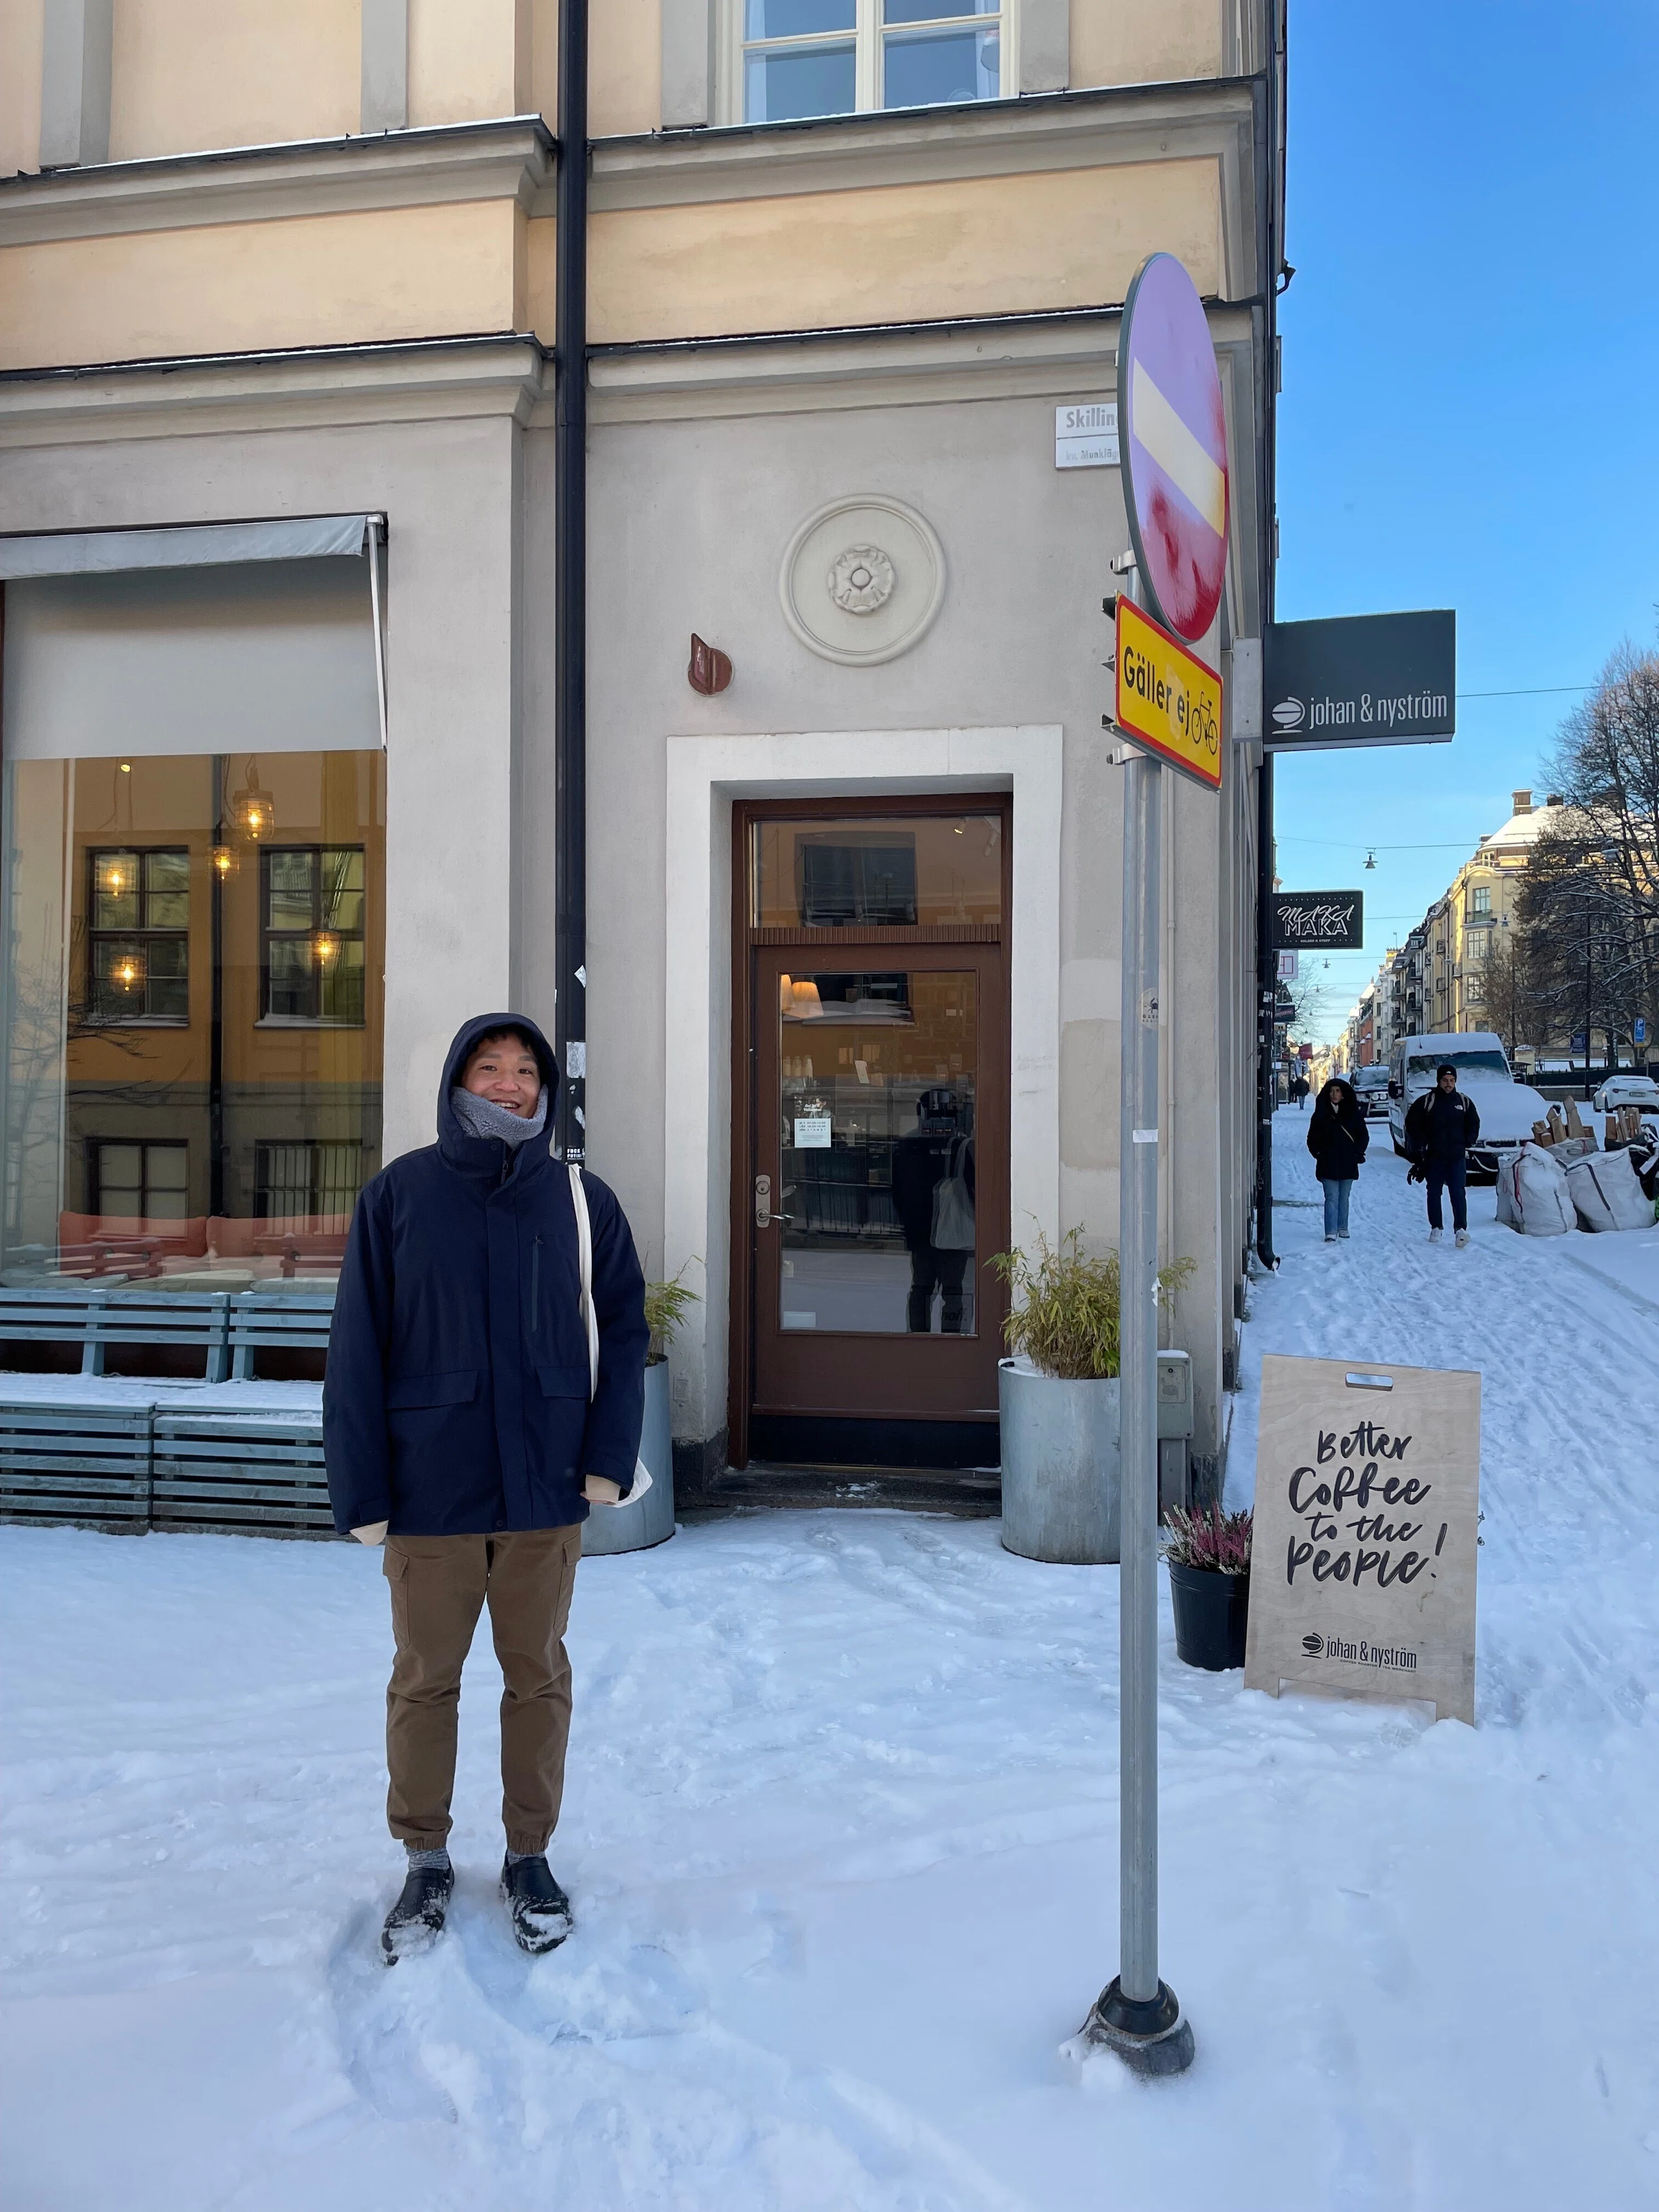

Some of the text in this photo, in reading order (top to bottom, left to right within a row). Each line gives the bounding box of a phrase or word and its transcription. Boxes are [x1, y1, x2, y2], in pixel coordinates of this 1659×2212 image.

[1066, 407, 1118, 428] Skillin
[1124, 646, 1190, 736] Gäller ej
[1309, 690, 1447, 730] johan & nyström
[1285, 919, 1348, 936] MAKA
[1317, 1421, 1413, 1464] Better
[1288, 1462, 1431, 1514] Coffee
[1304, 1511, 1423, 1542] to the
[1325, 1635, 1417, 1669] johan & nyström
